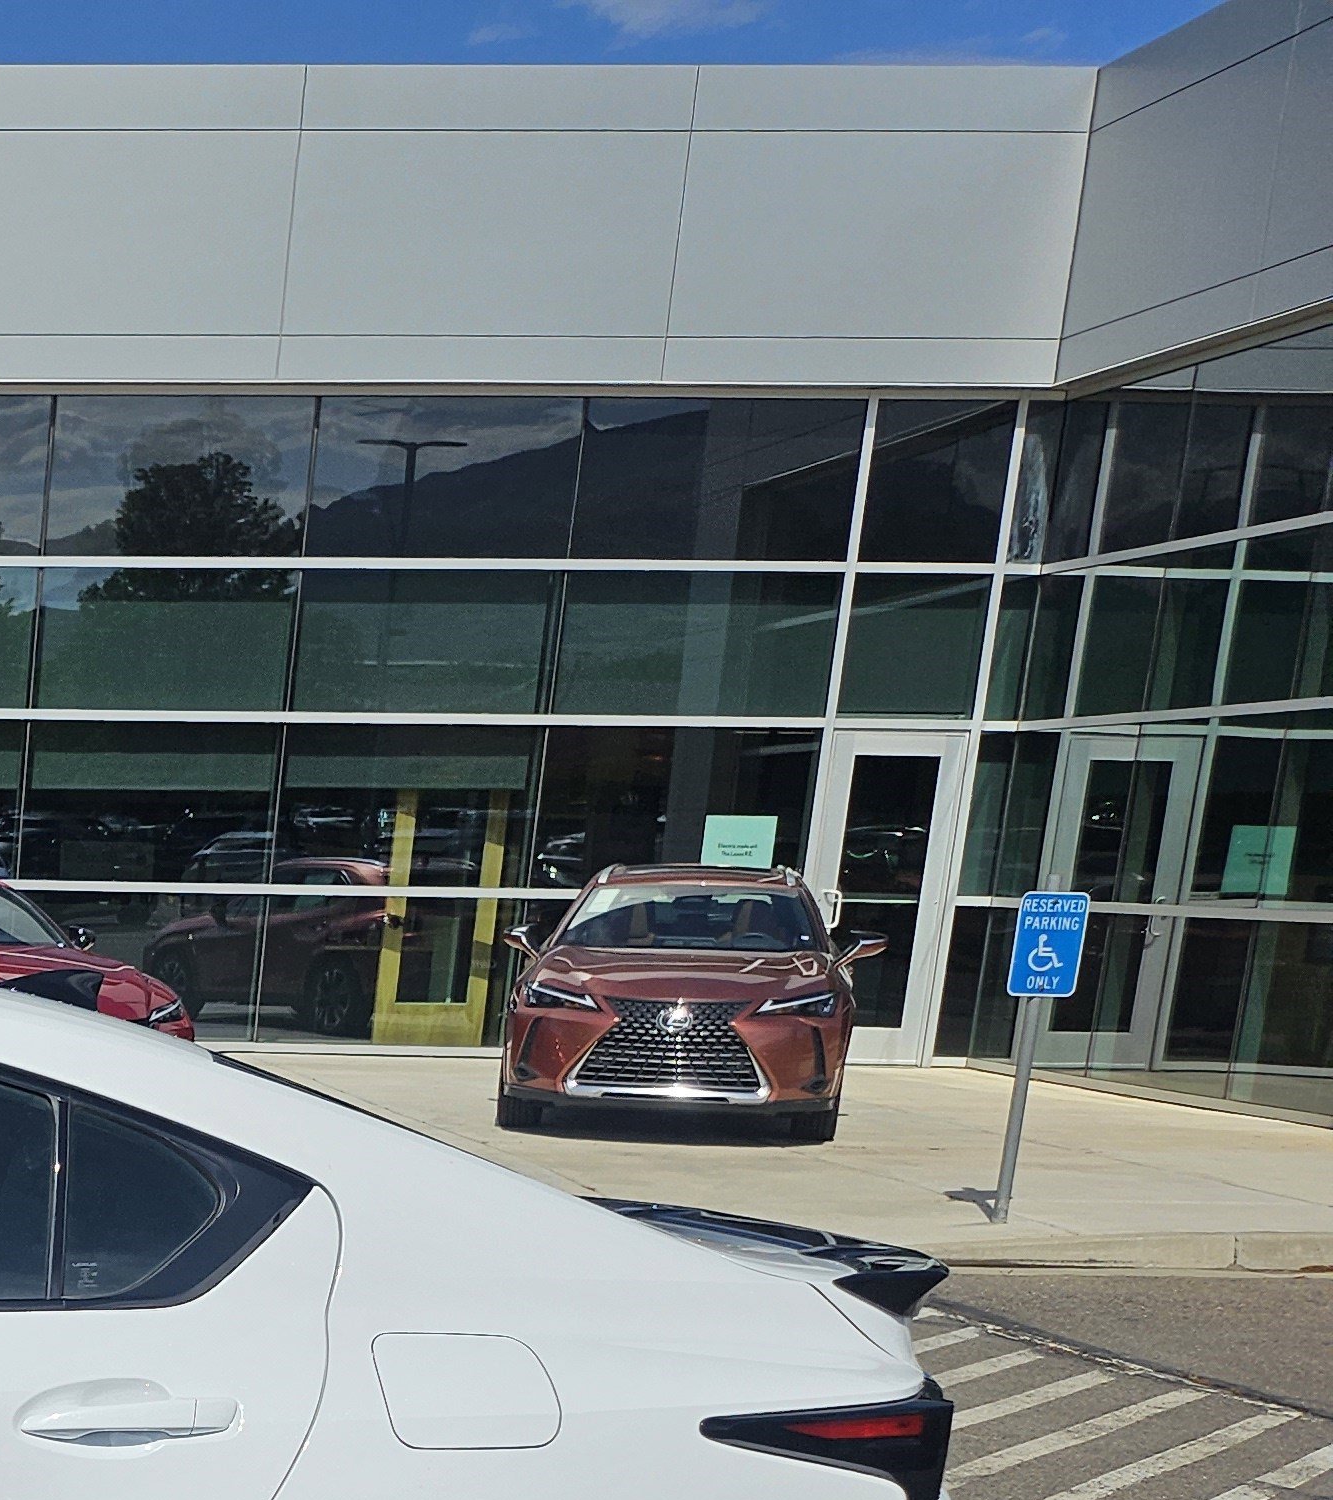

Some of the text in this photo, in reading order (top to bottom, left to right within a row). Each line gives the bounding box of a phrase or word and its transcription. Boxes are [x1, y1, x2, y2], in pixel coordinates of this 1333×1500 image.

[1023, 898, 1086, 913] RESERVED
[1024, 915, 1080, 931] PARKING
[1026, 975, 1061, 990] ONLY
